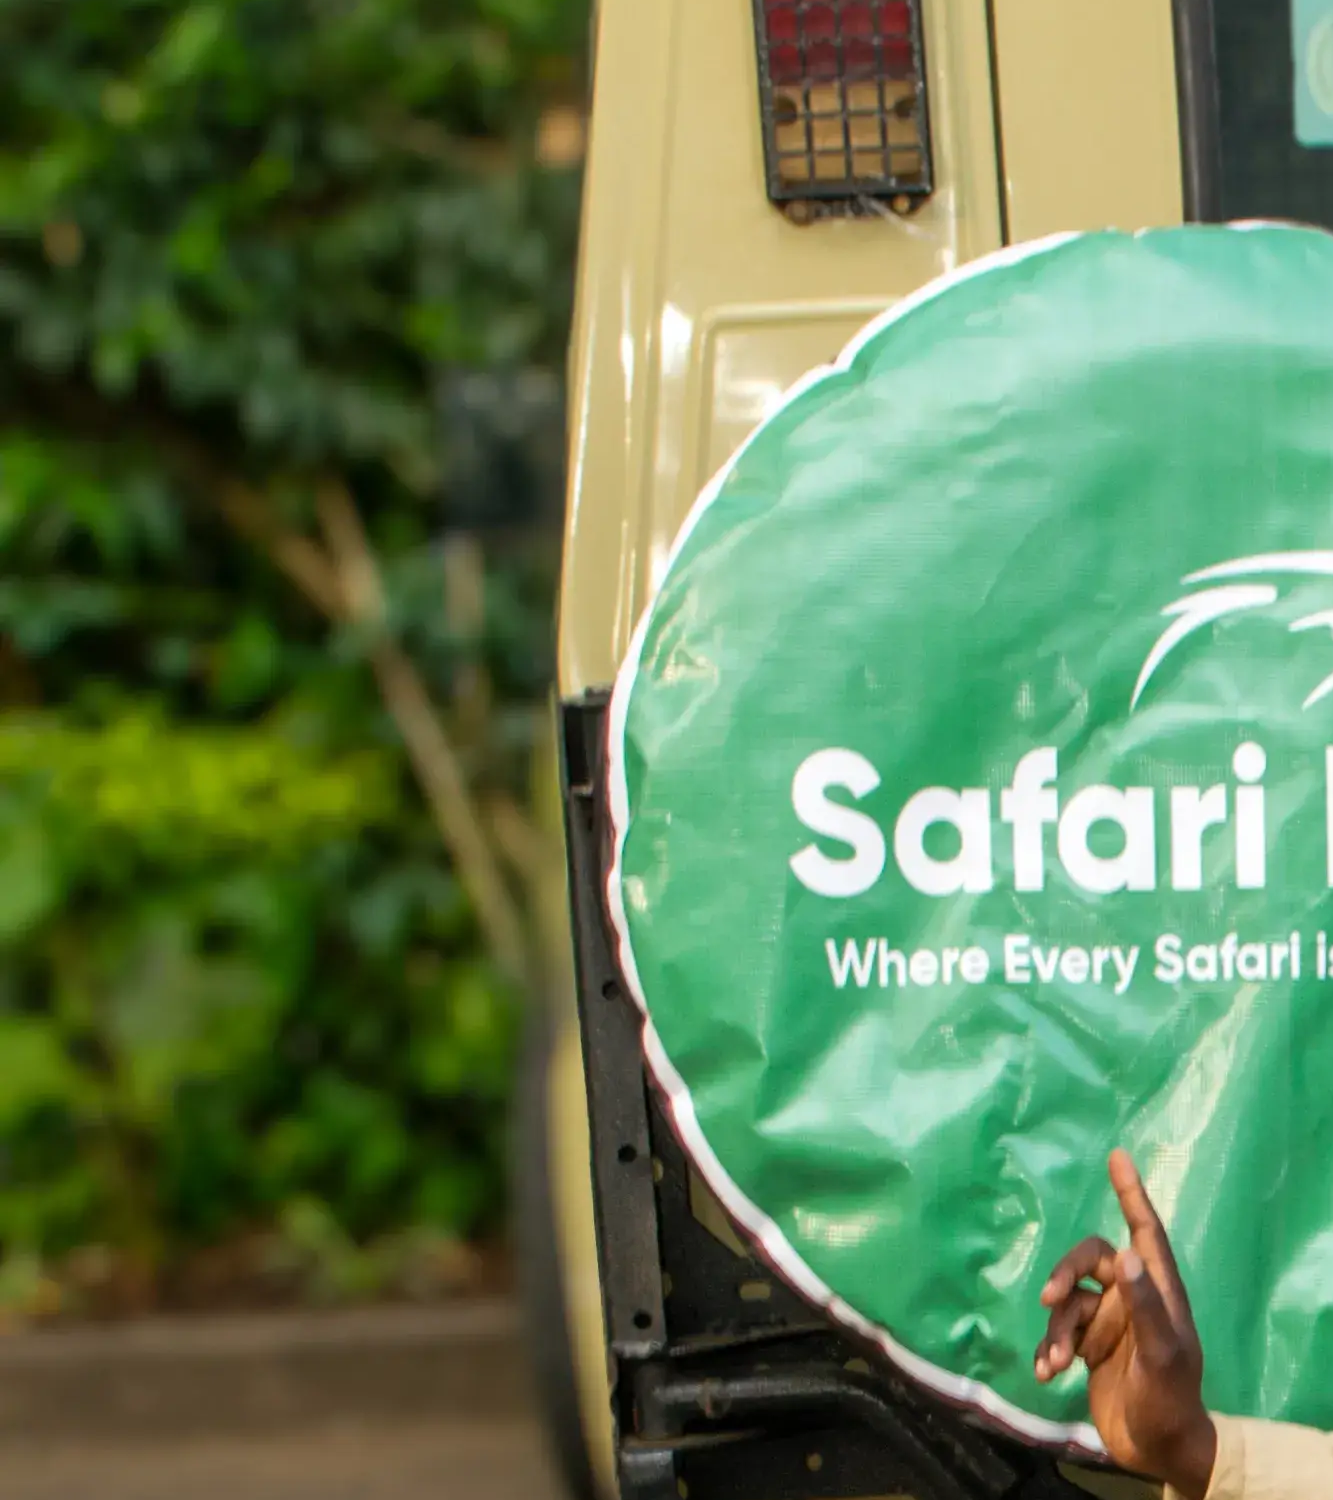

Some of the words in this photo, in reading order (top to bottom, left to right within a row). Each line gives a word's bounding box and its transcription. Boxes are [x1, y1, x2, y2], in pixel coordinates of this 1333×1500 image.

[790, 741, 1268, 898] Safari
[825, 936, 990, 988] Where
[1003, 933, 1140, 995] Every
[1154, 930, 1300, 983] Safari
